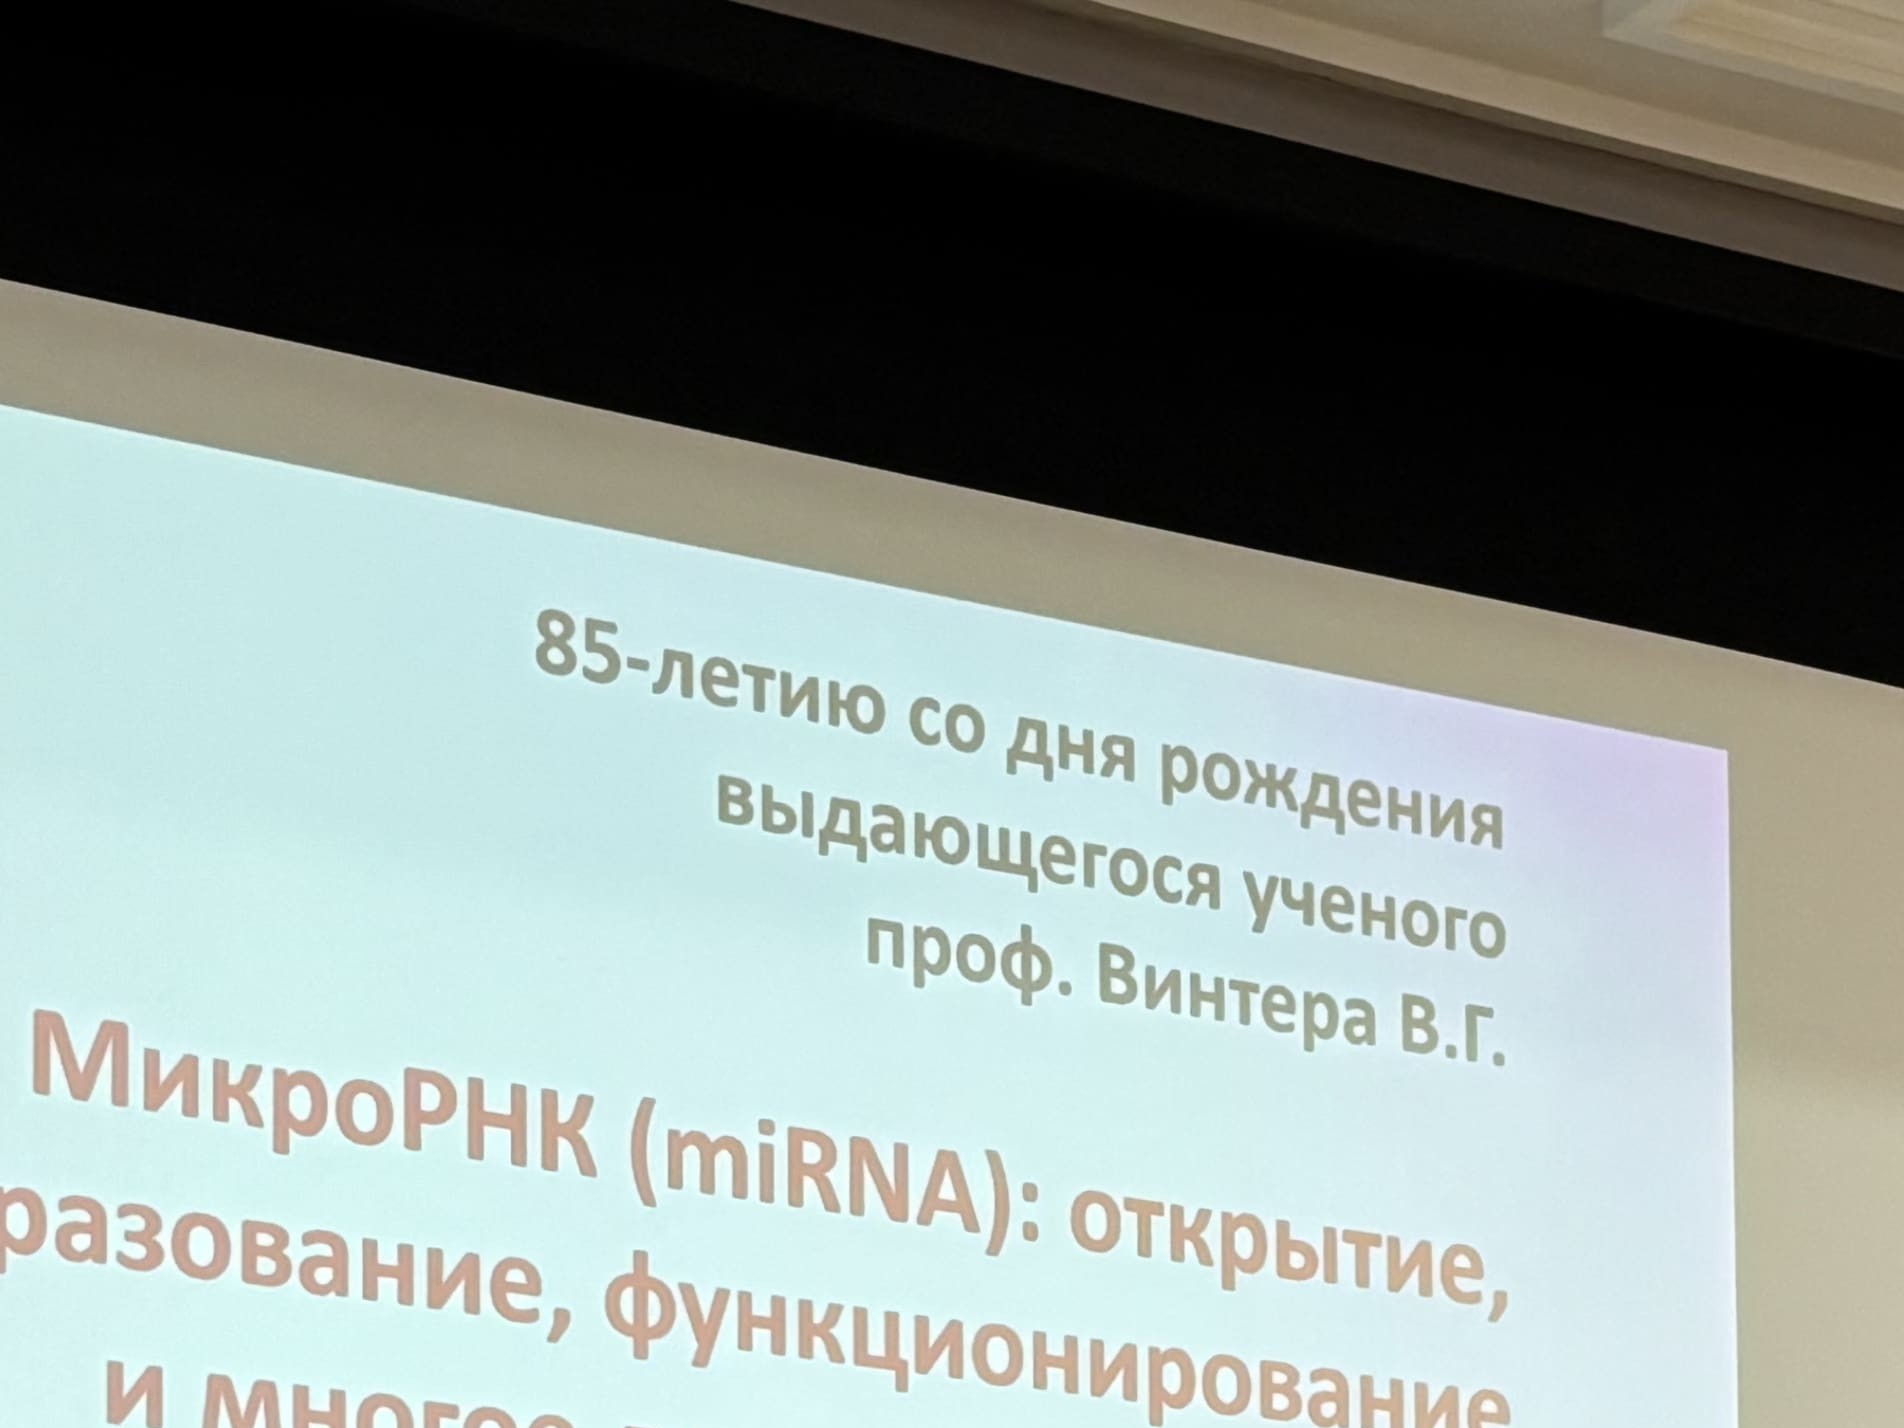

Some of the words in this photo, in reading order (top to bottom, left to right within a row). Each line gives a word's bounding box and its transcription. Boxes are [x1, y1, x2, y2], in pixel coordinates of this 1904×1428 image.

[536, 609, 886, 734] 85-летию
[909, 697, 985, 753] со
[1006, 717, 1135, 782] дня
[1161, 744, 1503, 849] рождения
[718, 774, 1220, 910] выдающегося
[1243, 871, 1506, 959] ученого
[868, 918, 1072, 1006] проф.
[1099, 942, 1376, 1052] Винтера
[1402, 993, 1505, 1066] В.Г.
[33, 1009, 597, 1178] МикроРНК
[631, 1097, 1039, 1256] (miRNA):
[1070, 1190, 1508, 1323] открытие,
